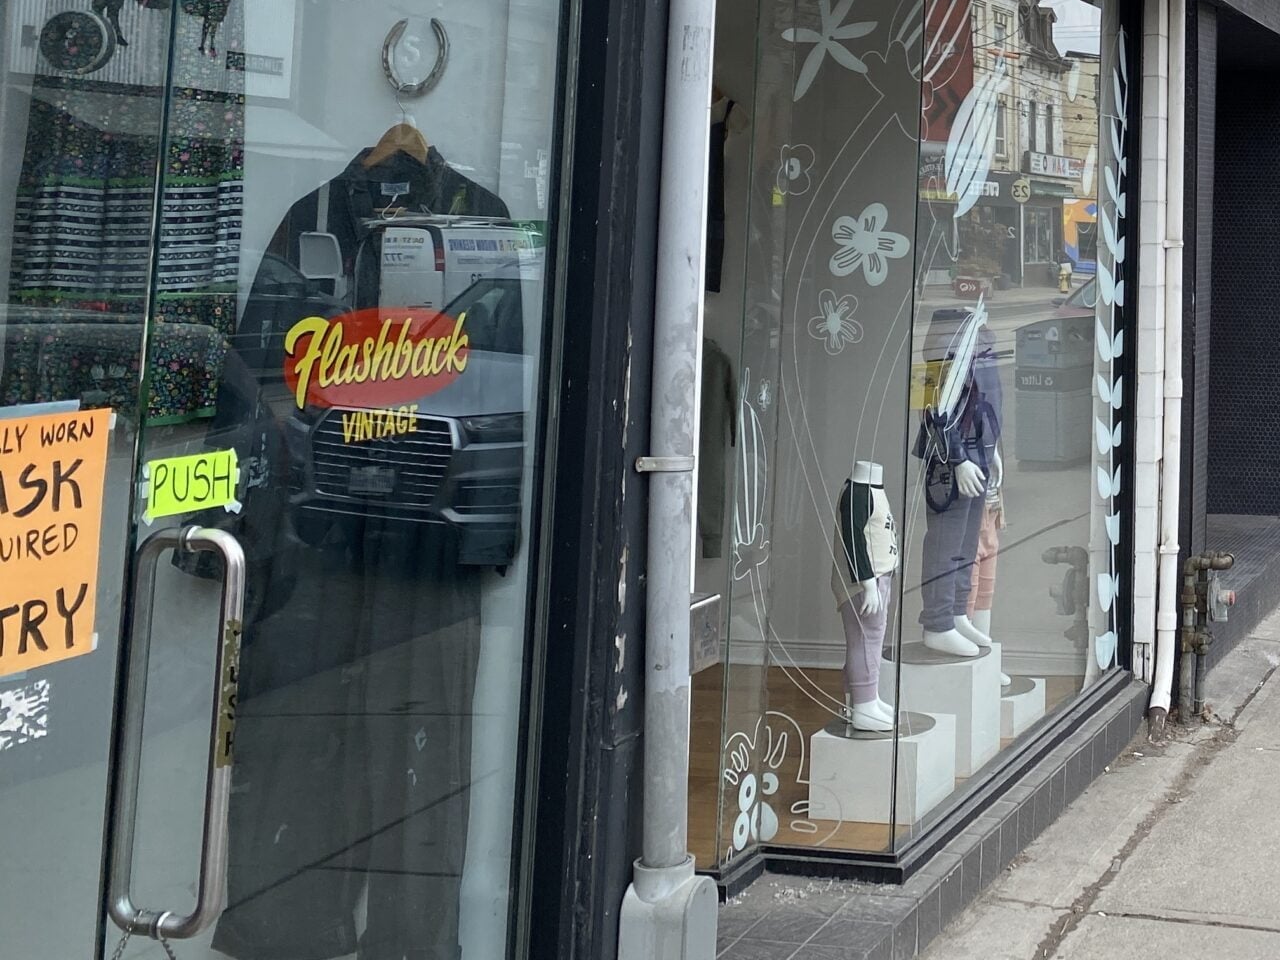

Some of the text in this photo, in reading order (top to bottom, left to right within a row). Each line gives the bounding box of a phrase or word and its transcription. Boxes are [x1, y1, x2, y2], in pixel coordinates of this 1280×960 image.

[284, 312, 470, 408] Flashback
[0, 417, 94, 454] LY WORN
[342, 404, 418, 443] VINTAGE
[154, 460, 234, 507] PUSH
